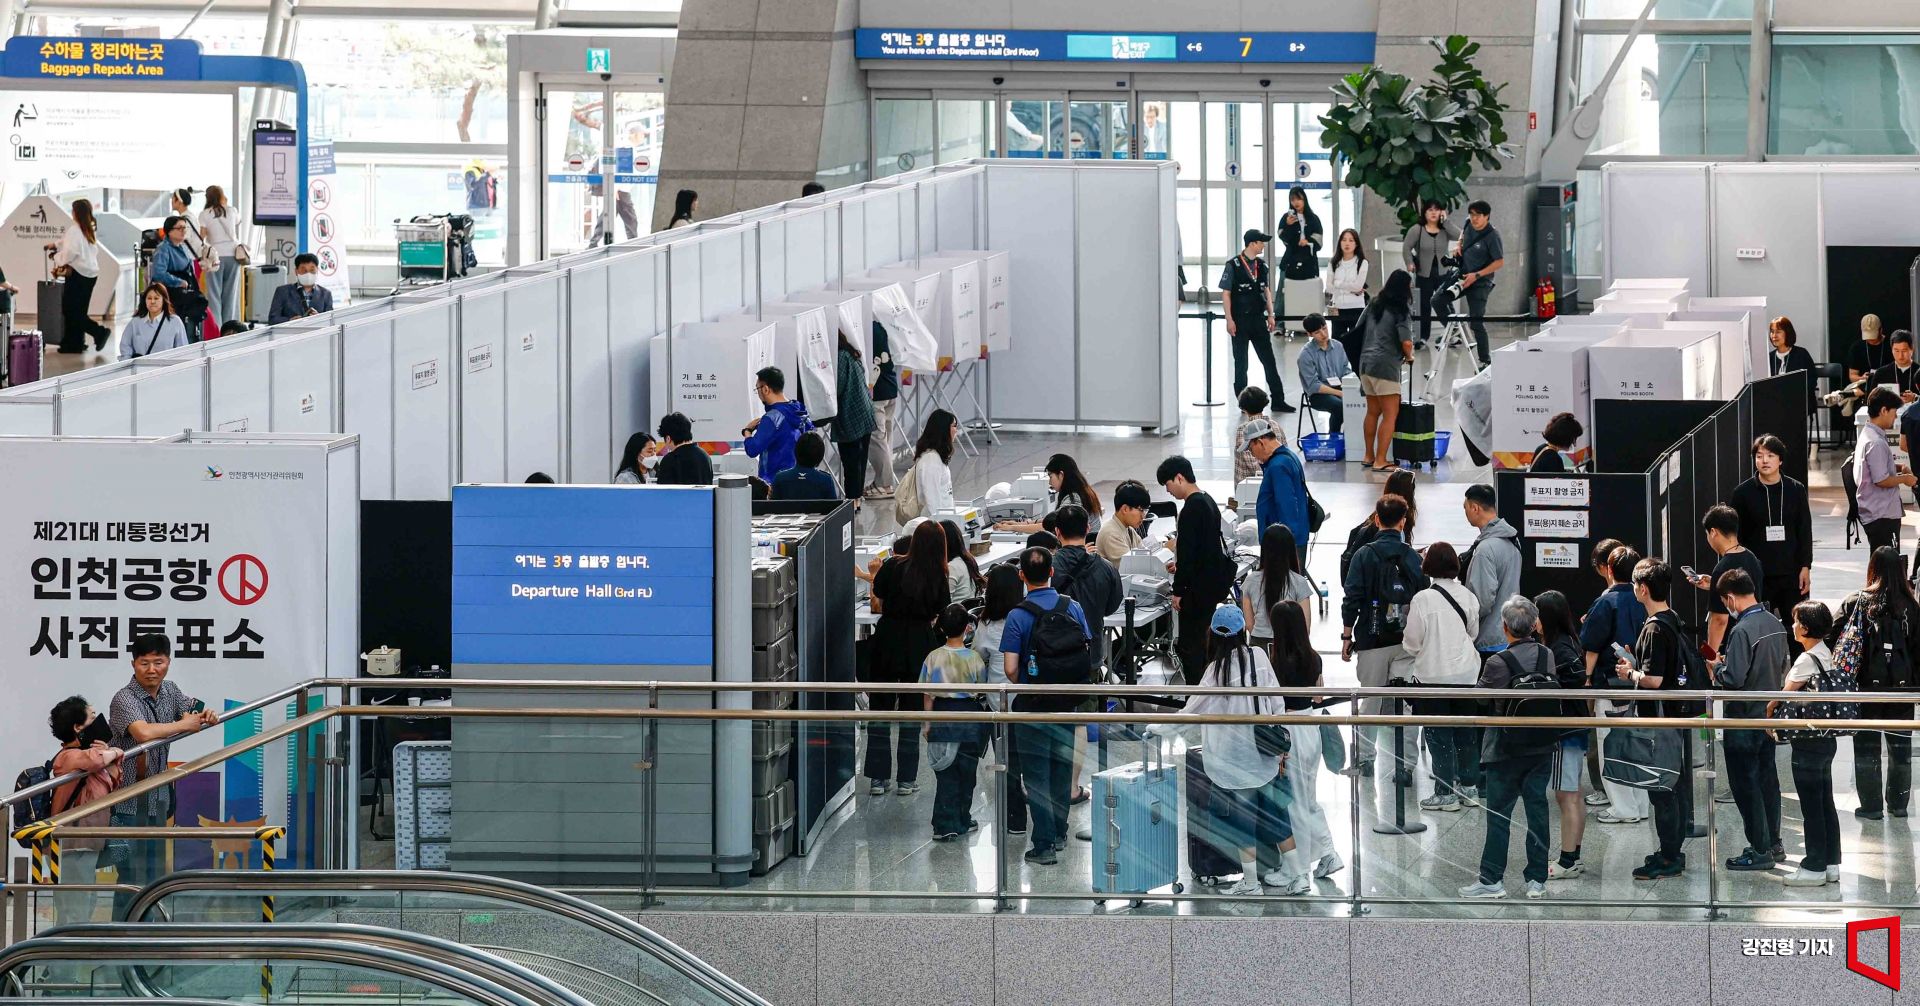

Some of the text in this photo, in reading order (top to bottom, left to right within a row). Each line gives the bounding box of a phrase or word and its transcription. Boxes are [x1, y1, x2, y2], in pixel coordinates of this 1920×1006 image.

[881, 33, 1006, 47] 여기는 3층 출발층 입니다
[1239, 37, 1253, 57] 7
[40, 42, 164, 61] 수하물 정리하는곳
[909, 47, 925, 55] here
[950, 48, 987, 57] Departures
[988, 48, 1002, 56] Hall
[1003, 48, 1017, 57] (3rd
[1018, 48, 1039, 57] Floor)
[1195, 43, 1202, 52] 6
[1289, 43, 1297, 52] 8
[40, 62, 164, 77] Baggage Repack Area
[13, 225, 31, 233] 수하물
[228, 471, 304, 480] 인천광역시선거관리위원회
[1530, 487, 1584, 497] 투표지 촬영 금지
[1527, 518, 1585, 528] 투표(용)지 훼손 금지
[33, 521, 210, 543] 제21대 대통령선거
[515, 554, 650, 569] 여기는 3층 출발층 입니다.
[30, 557, 212, 602] 인천공항
[511, 584, 653, 600] Departure Hall (3rd FL)
